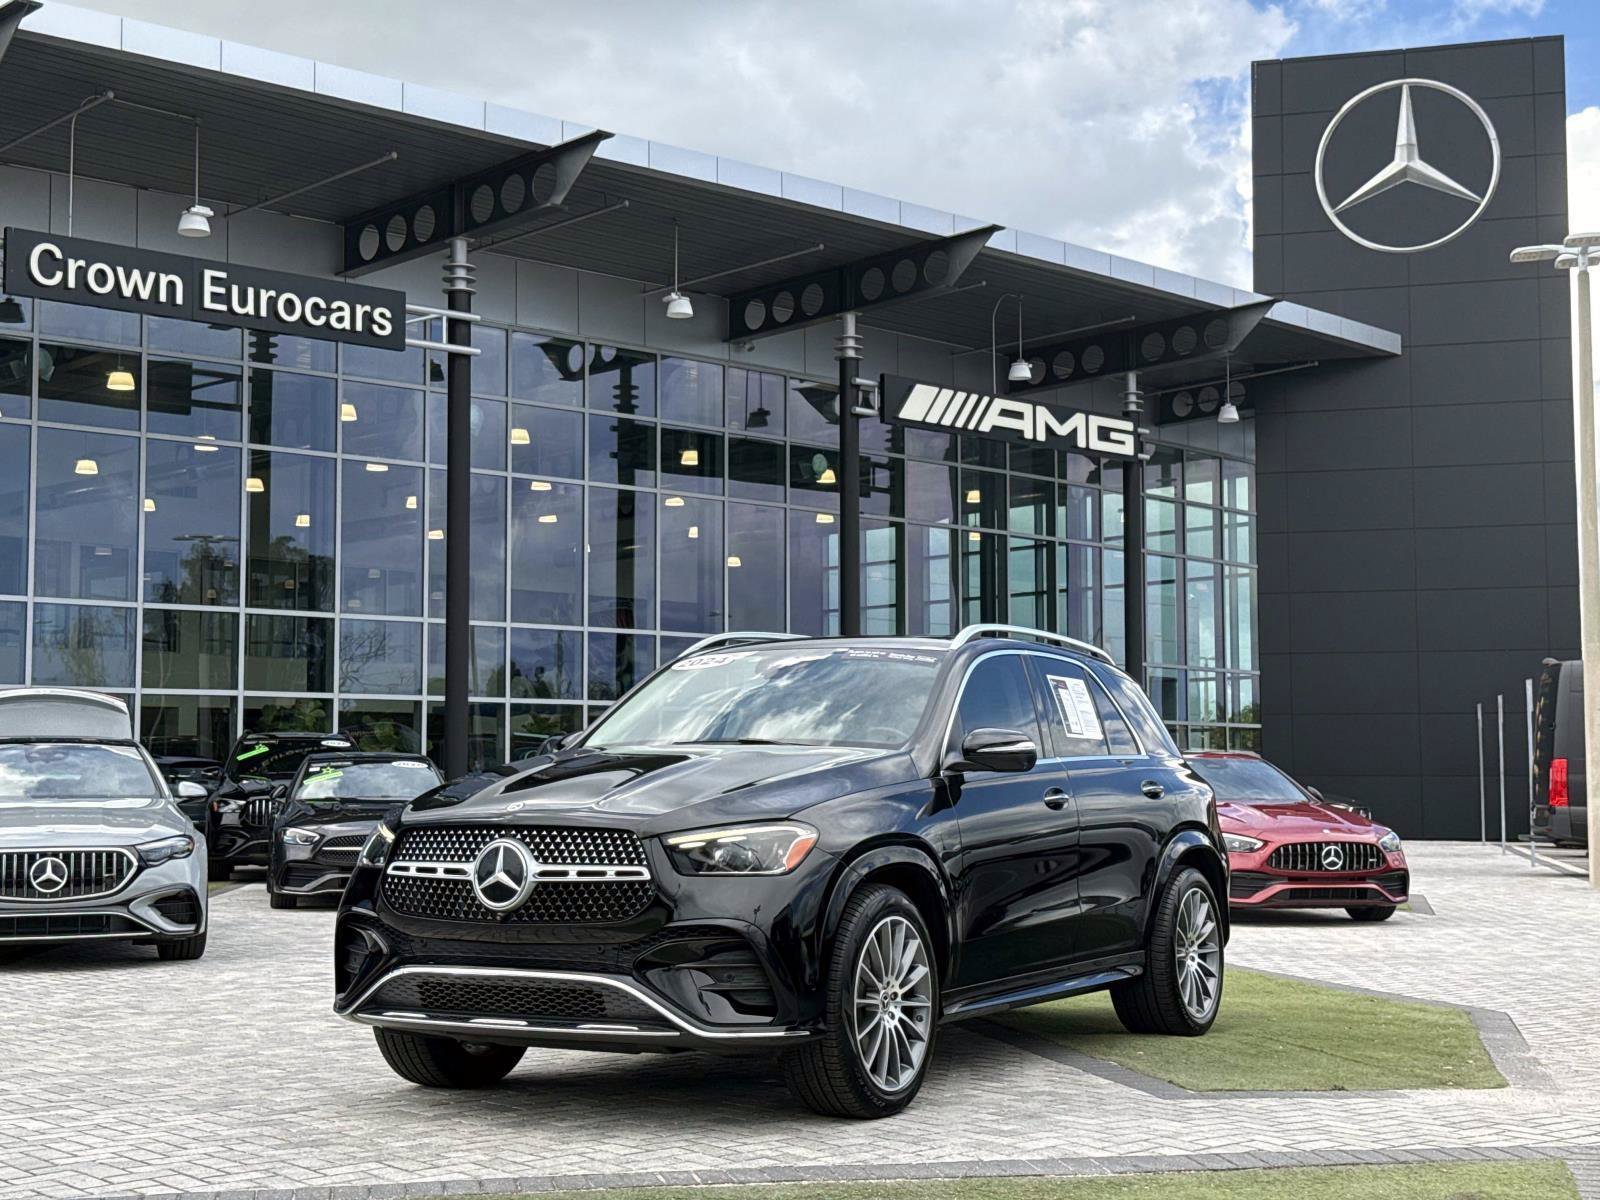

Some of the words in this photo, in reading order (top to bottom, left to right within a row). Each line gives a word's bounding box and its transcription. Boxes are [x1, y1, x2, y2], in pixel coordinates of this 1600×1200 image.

[29, 242, 183, 305] Crown
[202, 269, 394, 337] Eurocars
[977, 397, 1135, 457] AMG
[678, 656, 730, 667] 2024
